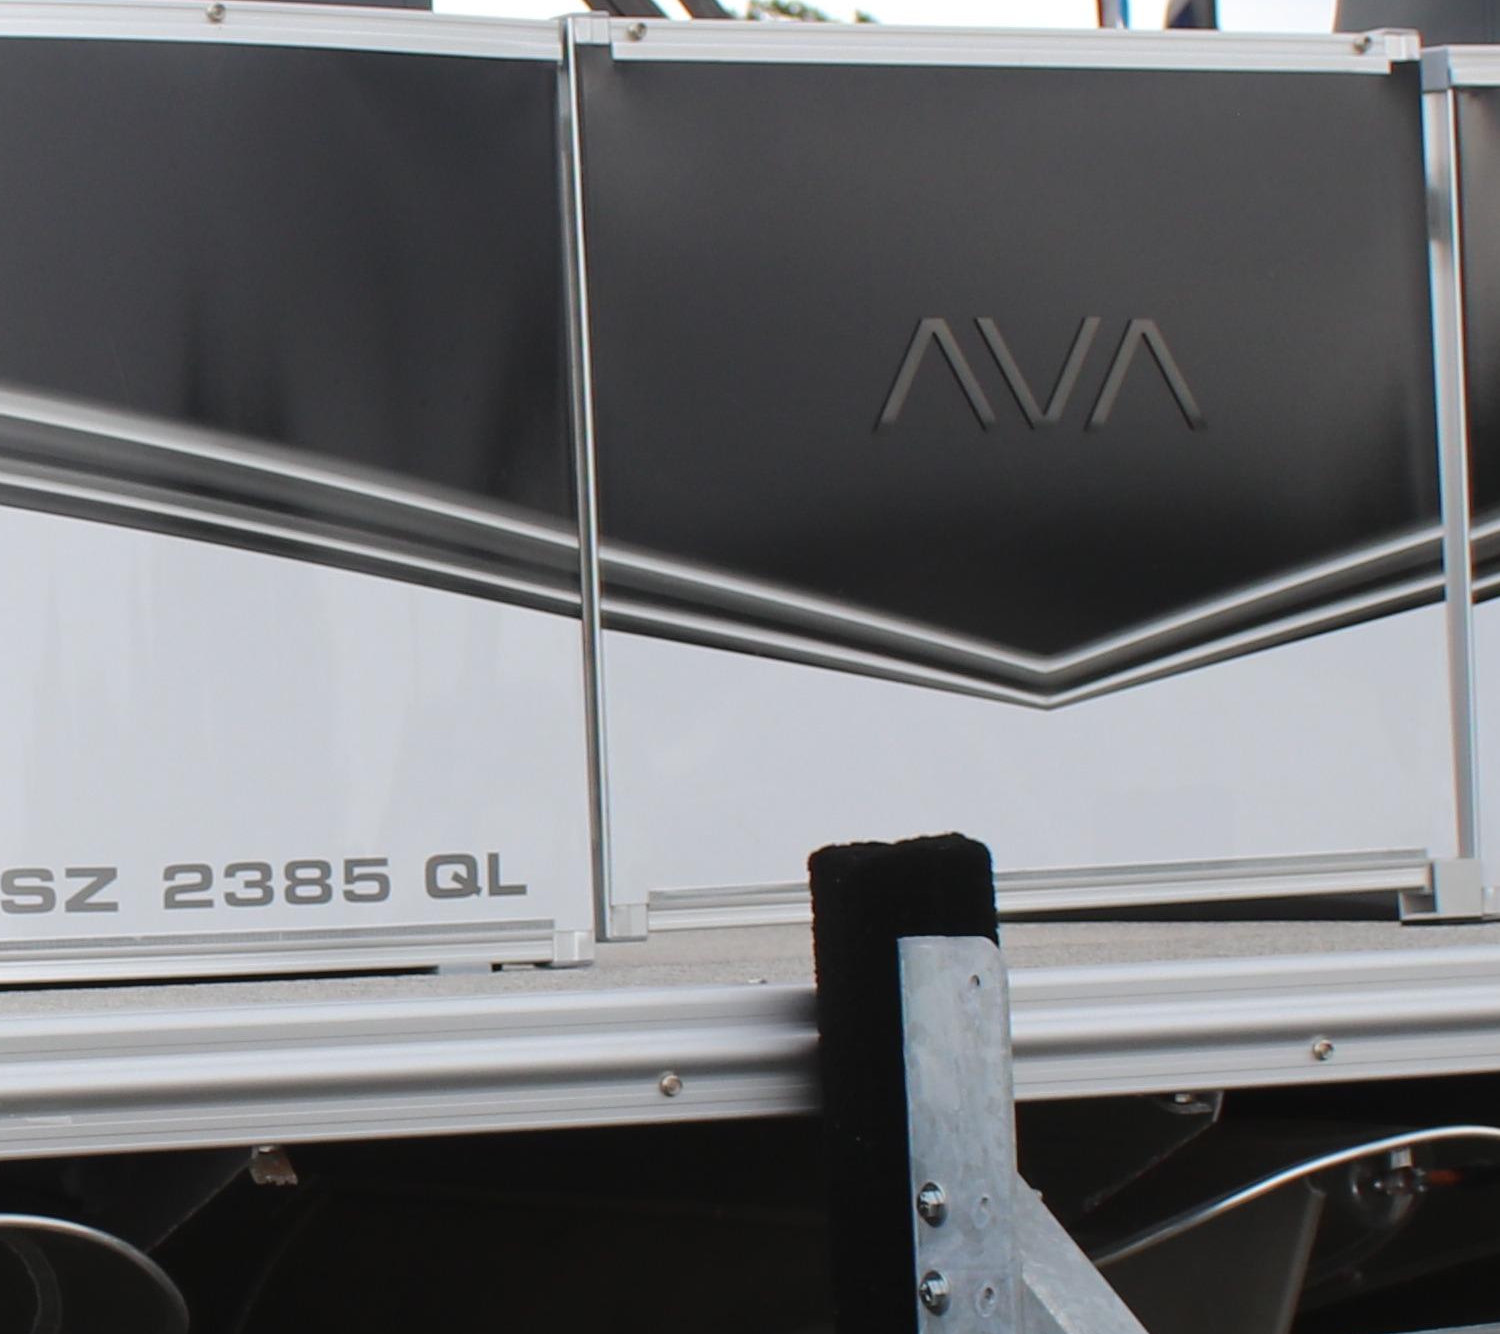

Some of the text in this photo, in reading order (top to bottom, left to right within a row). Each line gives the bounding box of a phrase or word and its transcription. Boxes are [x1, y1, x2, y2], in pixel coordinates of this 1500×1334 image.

[872, 316, 1203, 431] AVA
[162, 856, 391, 911] 2385
[424, 851, 528, 900] QL
